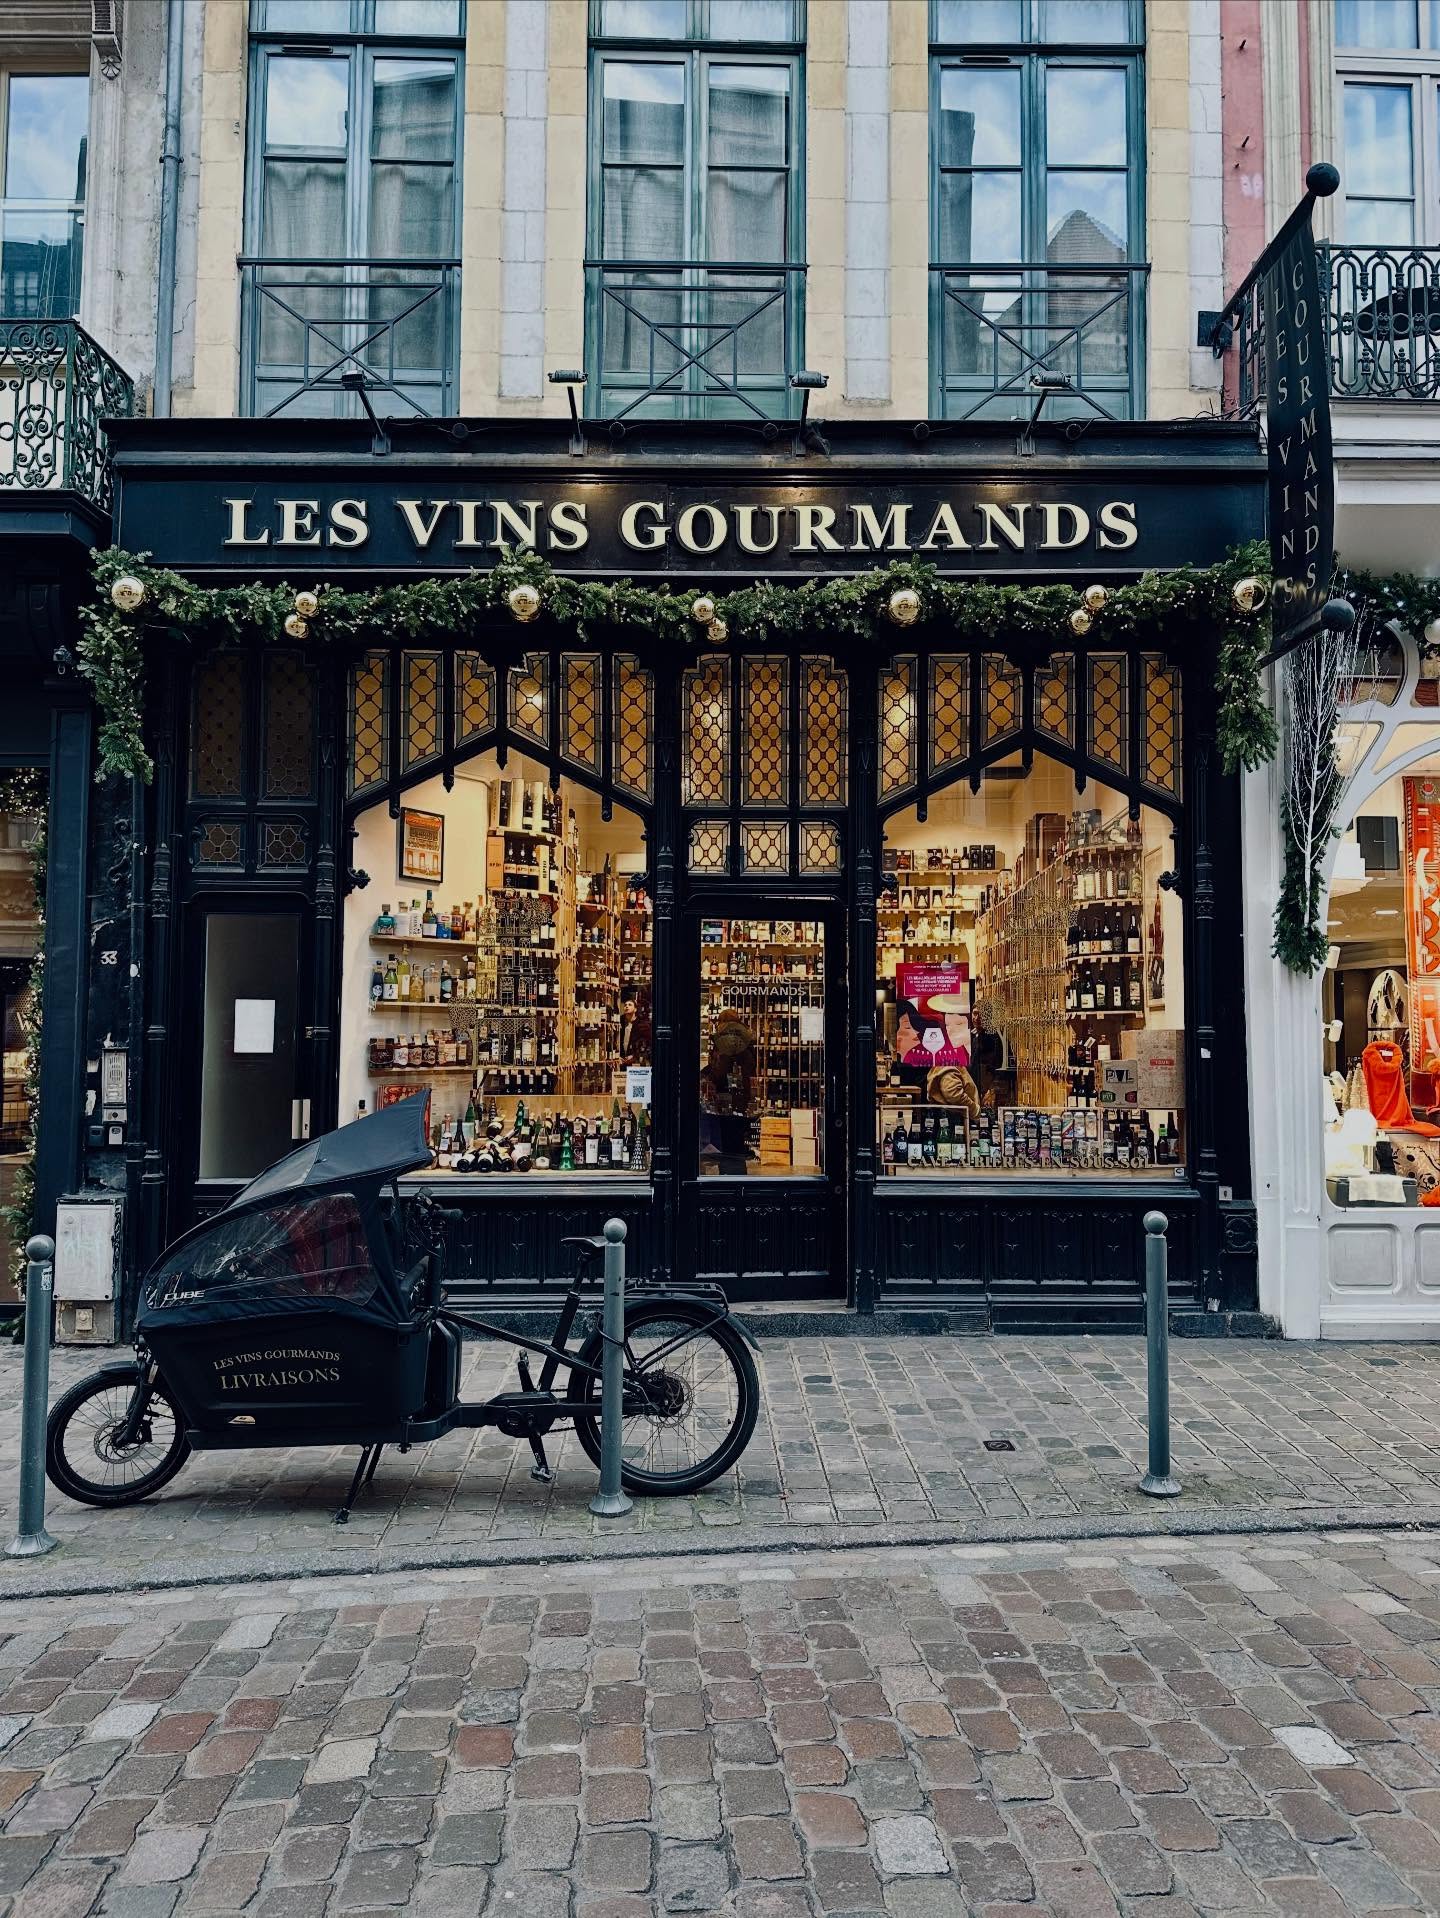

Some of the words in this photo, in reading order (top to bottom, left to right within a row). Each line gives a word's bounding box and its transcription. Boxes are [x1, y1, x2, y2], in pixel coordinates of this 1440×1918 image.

[1273, 287, 1288, 405] LES
[1292, 261, 1320, 590] GOURMANDS
[223, 498, 369, 548] LES
[396, 499, 589, 551] VINS
[619, 499, 1140, 554] GOURMANDS
[1277, 436, 1295, 604] VINS
[100, 950, 118, 965] 33
[735, 975, 760, 984] LES
[762, 975, 792, 984] VINS
[721, 986, 807, 996] GOURMANDS
[164, 1290, 205, 1302] CUBE
[213, 1358, 233, 1370] LES
[235, 1351, 262, 1364] VINS
[264, 1349, 341, 1362] GOURMANDS
[220, 1367, 340, 1389] LIVRAISONS
